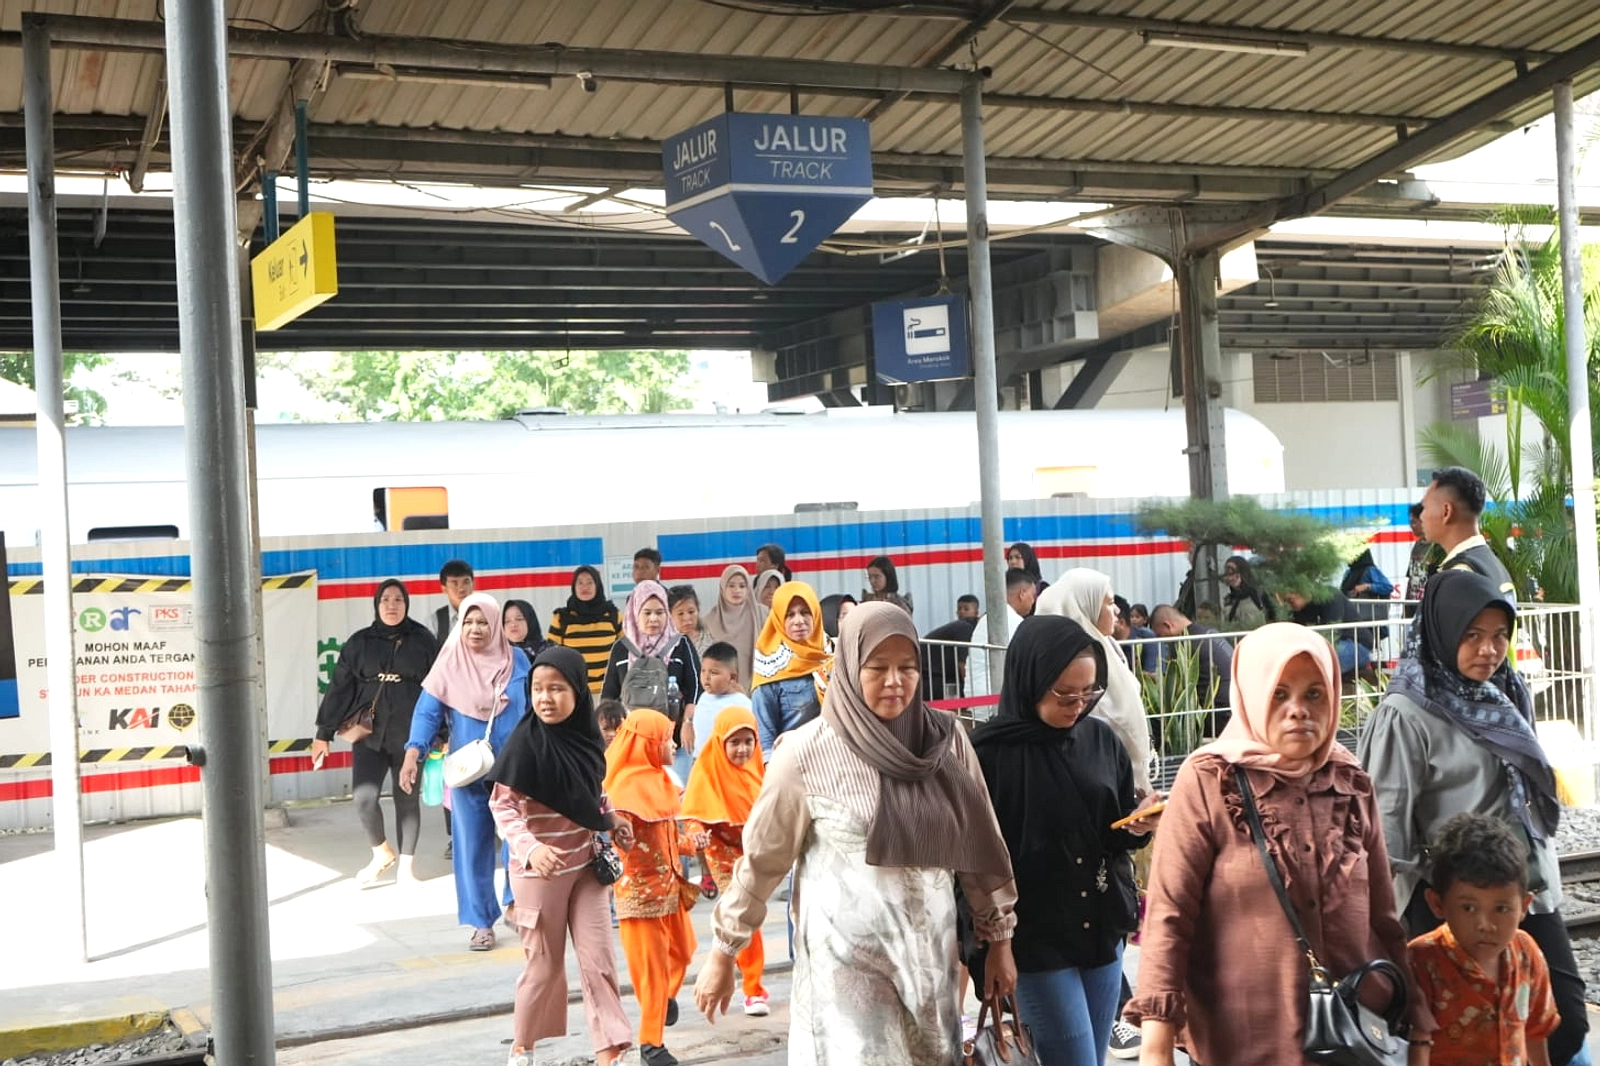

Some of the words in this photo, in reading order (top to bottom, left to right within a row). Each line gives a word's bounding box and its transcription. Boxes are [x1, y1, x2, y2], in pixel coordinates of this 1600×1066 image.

[753, 123, 848, 153] JALUR
[673, 128, 717, 170] JALUR
[680, 165, 712, 194] TRACK
[769, 159, 833, 180] TRACK
[779, 209, 806, 244] 2
[154, 608, 179, 619] PKS
[84, 642, 129, 653] MOHON
[133, 641, 167, 651] MAAF
[113, 654, 147, 665] ANDA
[100, 671, 194, 684] CONSTRUCTION
[94, 688, 111, 697] KA
[114, 685, 157, 696] MEDAN
[108, 707, 160, 731] KAI
